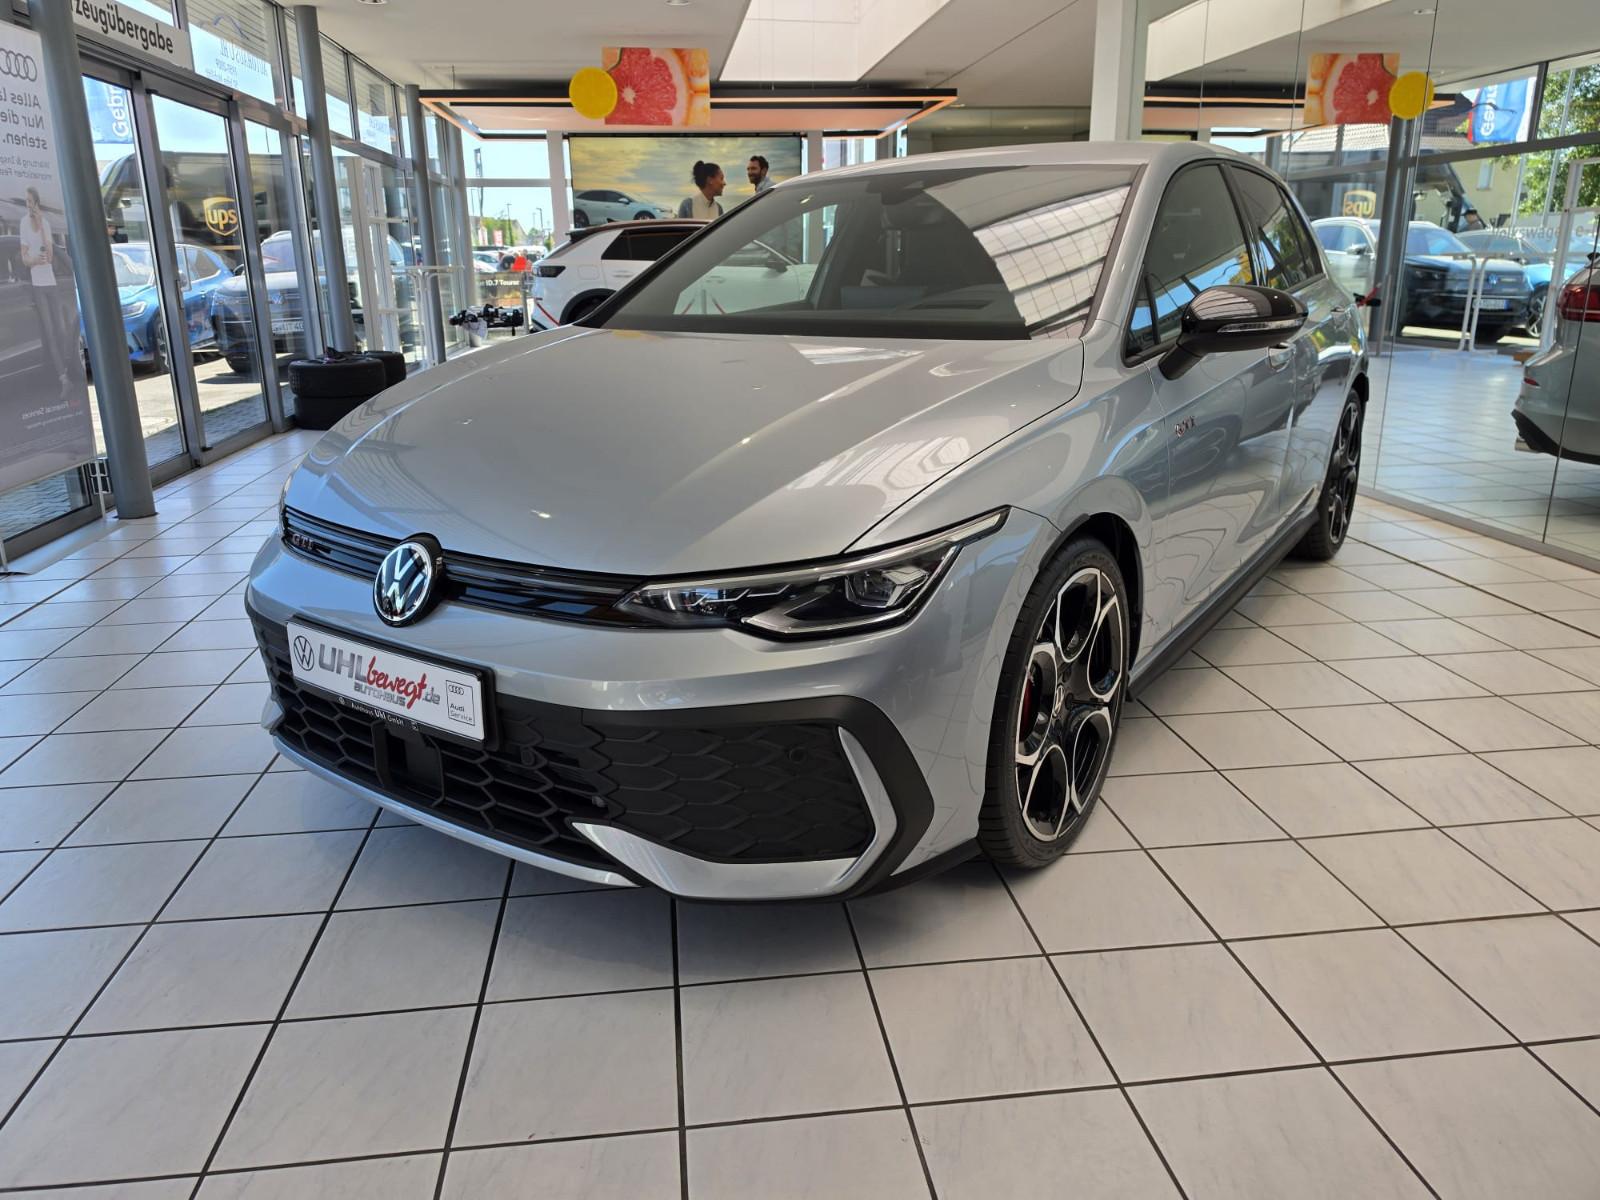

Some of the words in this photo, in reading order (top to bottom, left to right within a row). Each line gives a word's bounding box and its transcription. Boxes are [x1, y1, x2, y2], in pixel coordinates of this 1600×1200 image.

[71, 0, 174, 53] zeugübergabe
[207, 208, 238, 230] ups
[292, 533, 314, 551] GTI
[449, 703, 465, 713] Audi
[449, 710, 474, 723] Service
